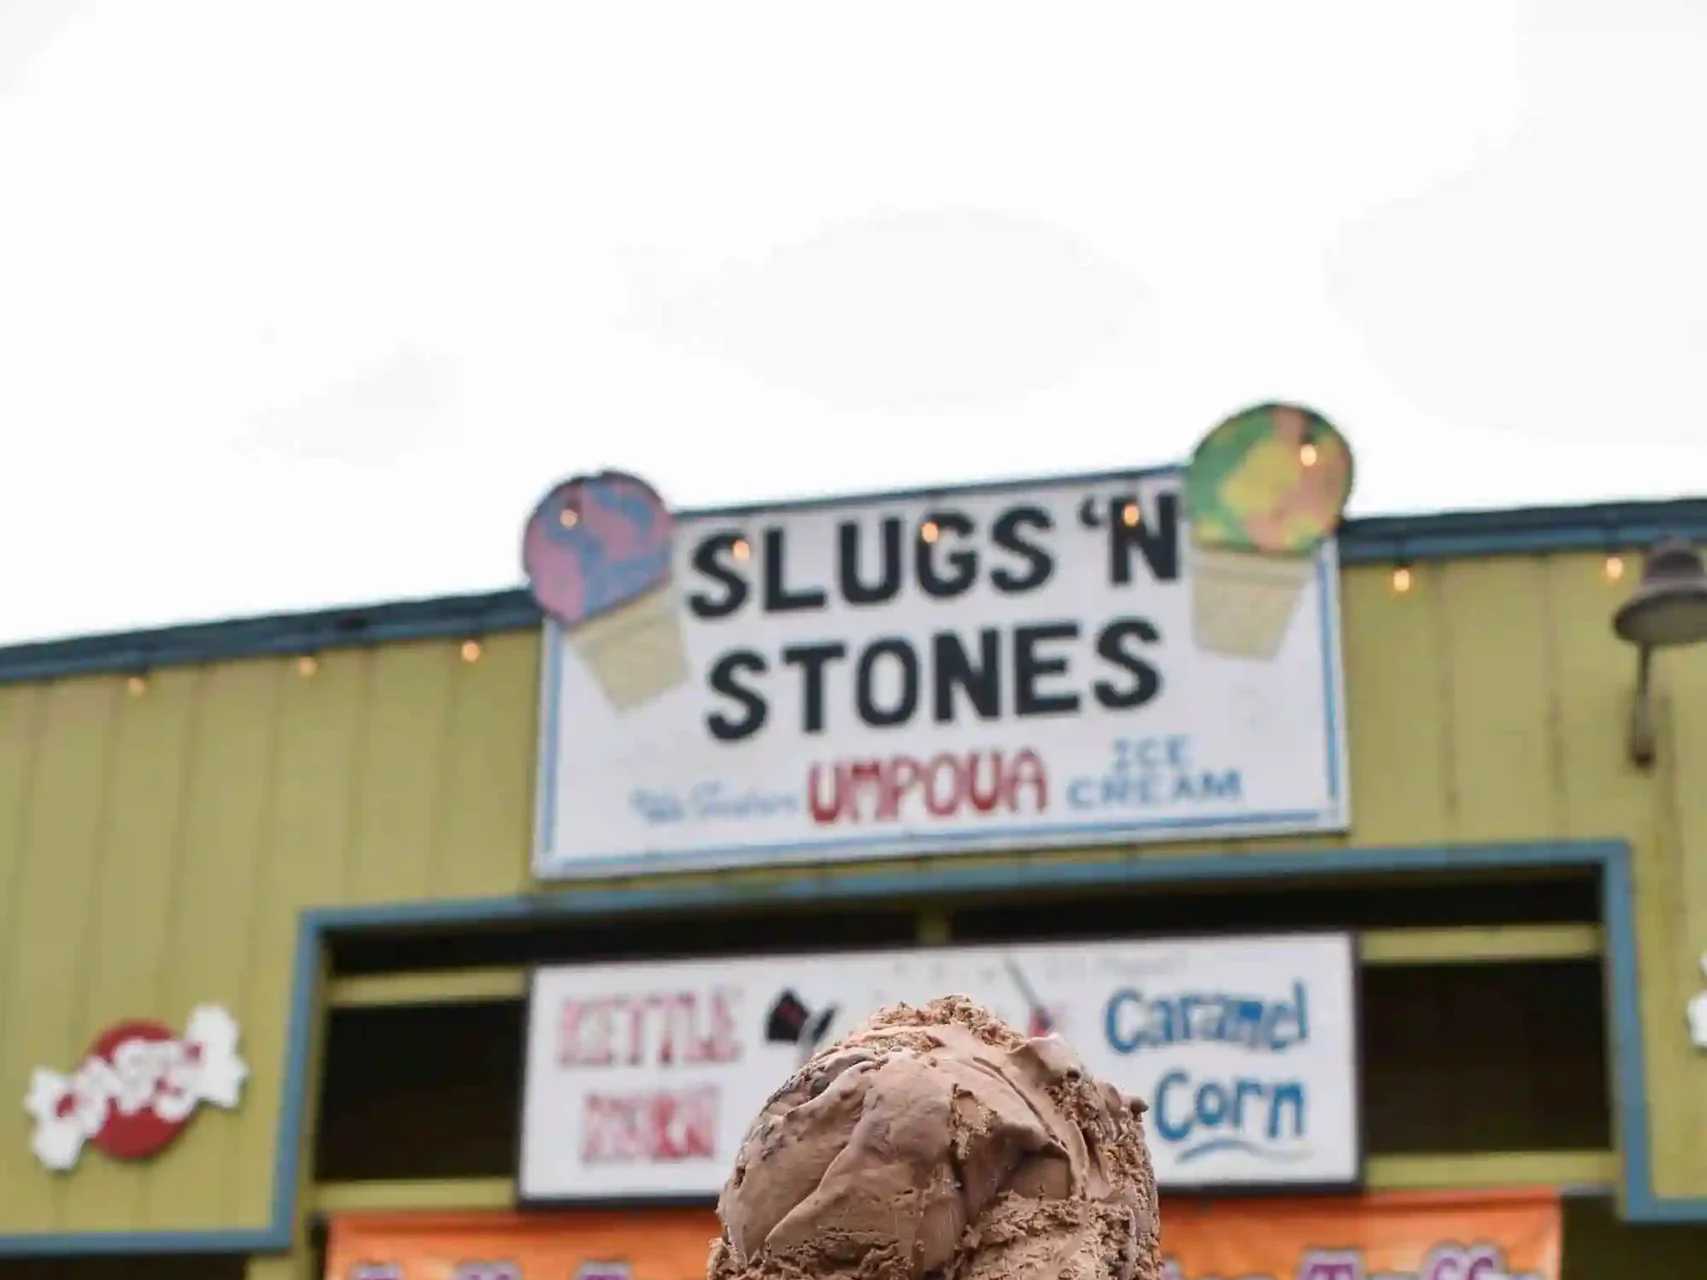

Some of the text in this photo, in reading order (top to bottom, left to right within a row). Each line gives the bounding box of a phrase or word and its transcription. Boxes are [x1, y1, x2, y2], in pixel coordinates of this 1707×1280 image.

[687, 507, 1056, 619] SLUGS
[706, 618, 1161, 743] STONES
[1154, 1069, 1305, 1141] Corn
